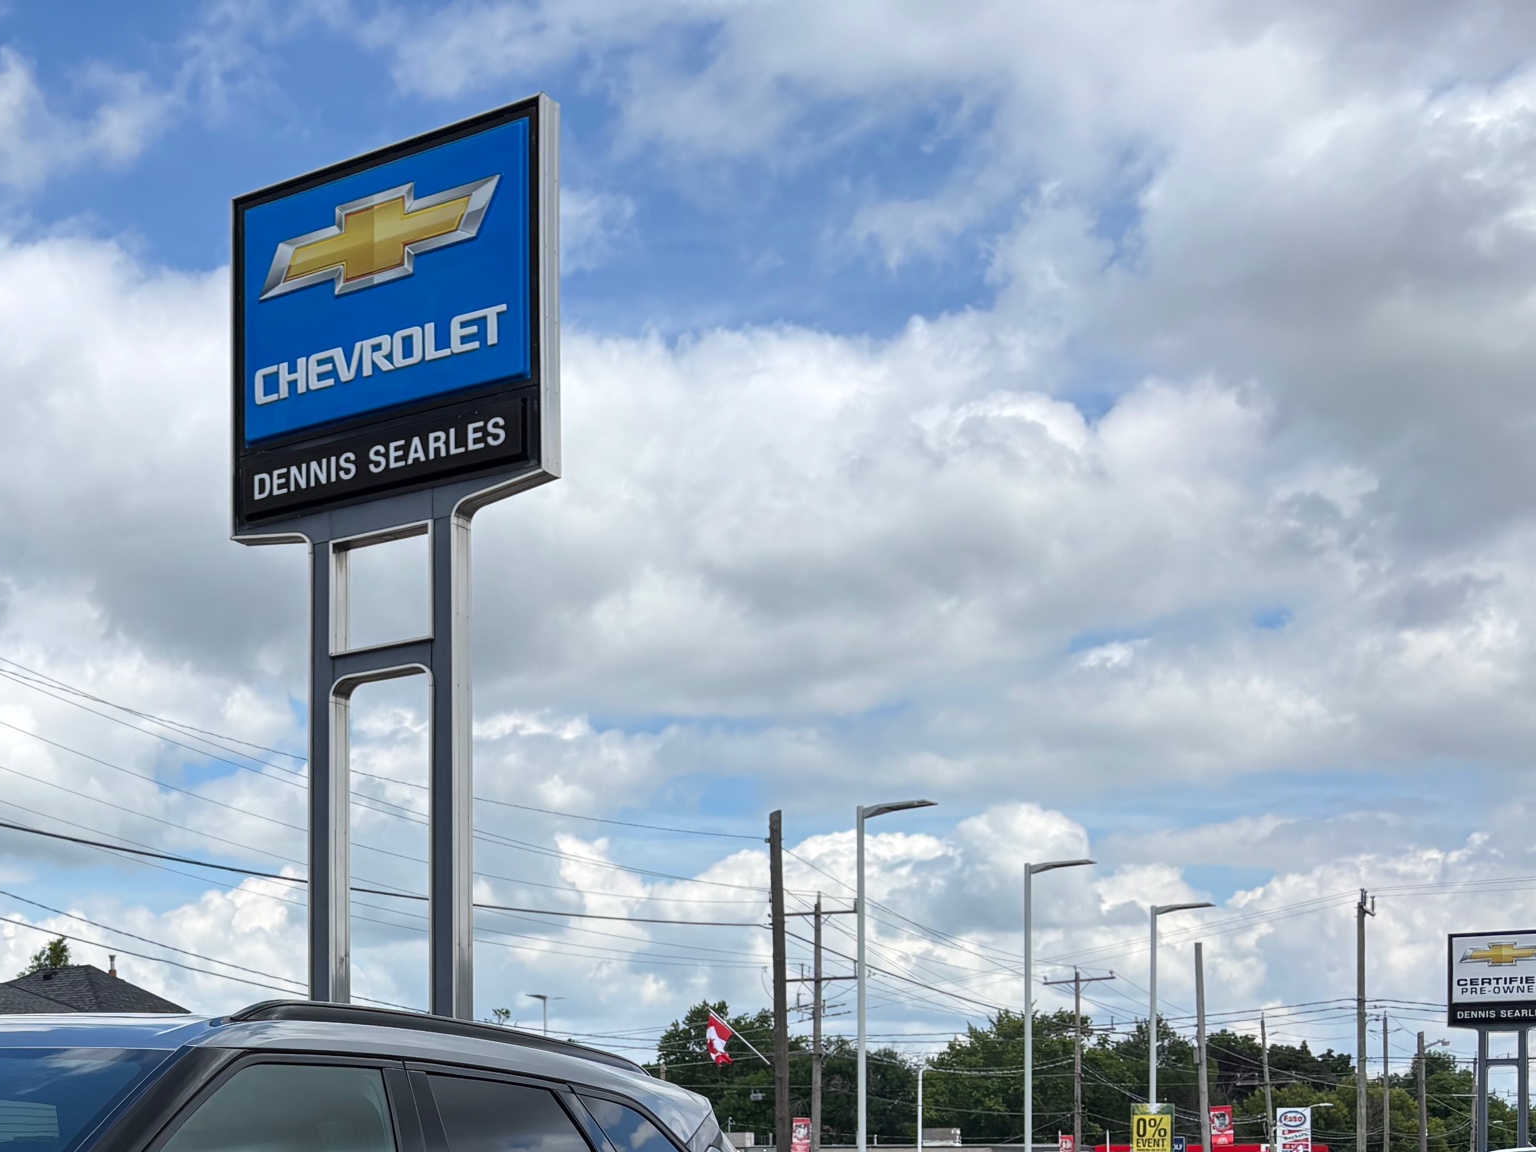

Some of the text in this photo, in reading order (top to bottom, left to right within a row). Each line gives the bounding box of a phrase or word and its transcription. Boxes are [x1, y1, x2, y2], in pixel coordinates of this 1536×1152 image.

[254, 303, 507, 406] CHEVROLET
[253, 416, 506, 501] DENNIS SEARLES
[1457, 1009, 1536, 1019] DENNIS SEARL
[1283, 1115, 1303, 1123] Esso
[1136, 1117, 1168, 1138] 0%
[1136, 1138, 1166, 1148] EVENT
